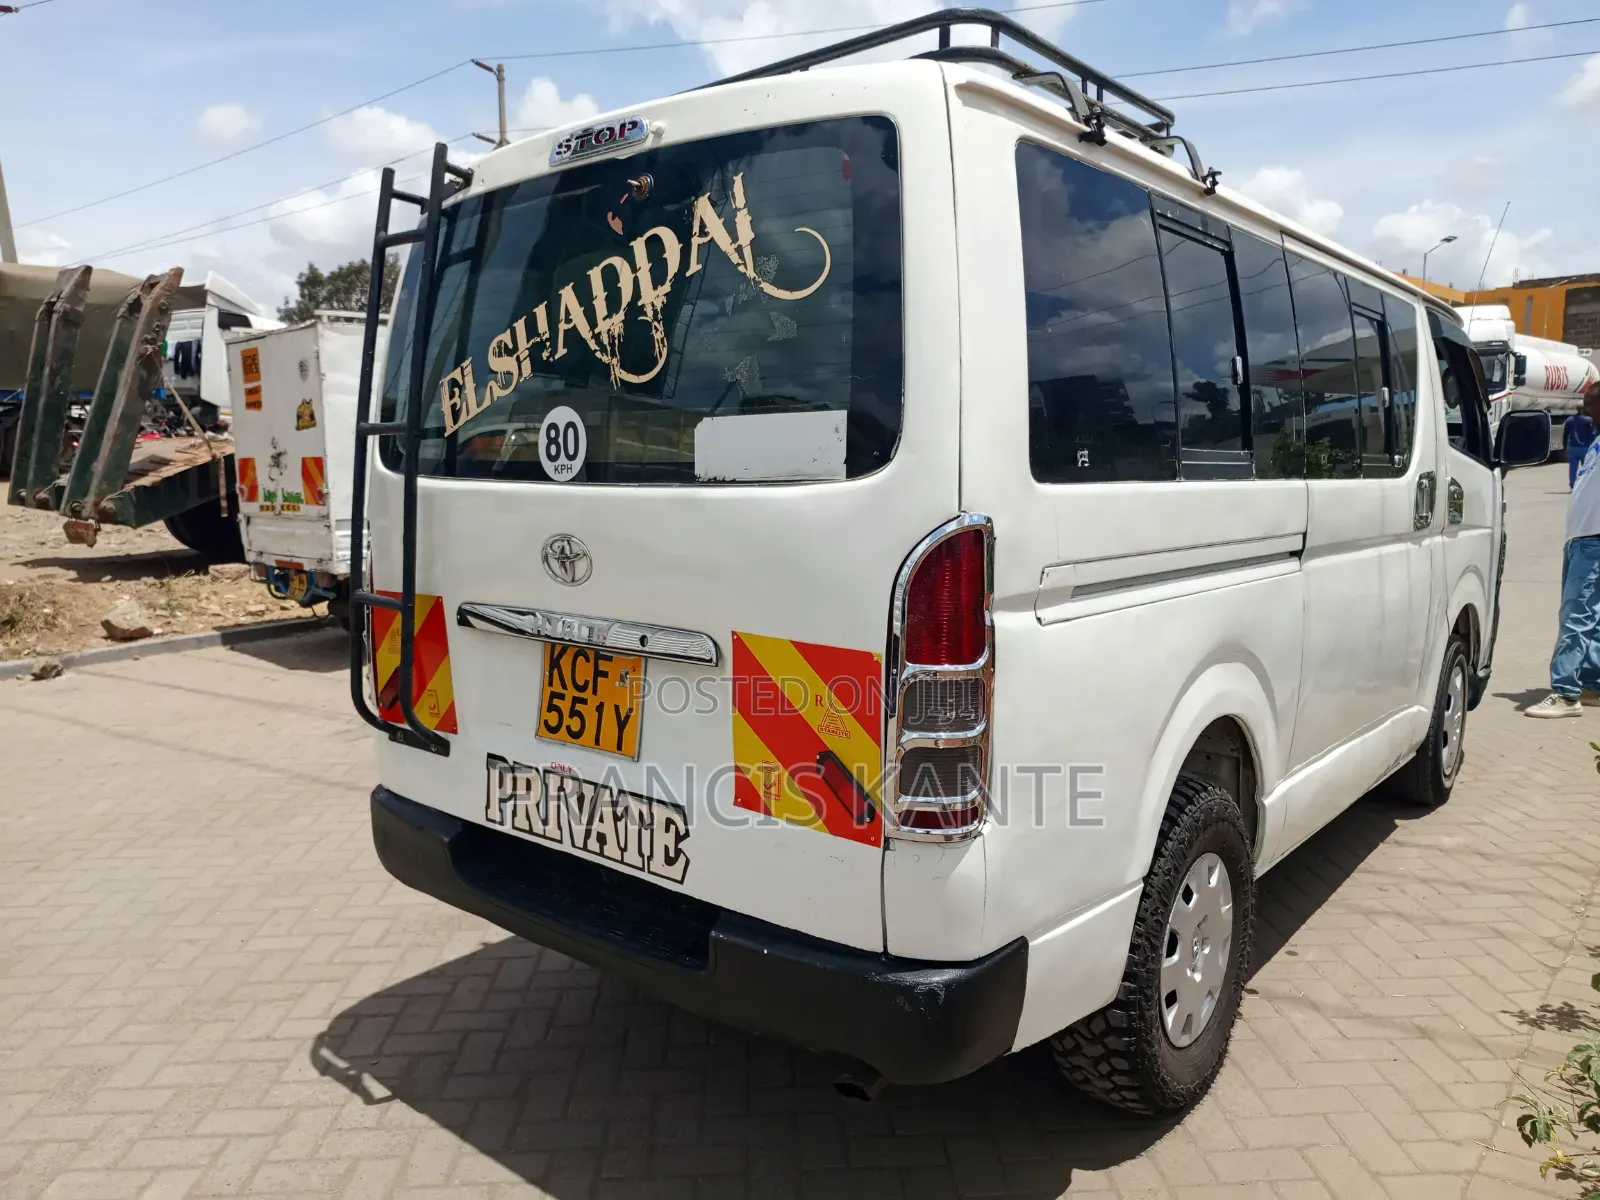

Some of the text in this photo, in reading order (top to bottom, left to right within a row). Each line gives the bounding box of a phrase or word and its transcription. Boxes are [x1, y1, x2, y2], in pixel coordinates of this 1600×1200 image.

[556, 120, 639, 156] STOP
[1544, 365, 1568, 391] RUBIS
[545, 420, 579, 463] 80
[554, 464, 573, 475] KPH
[547, 643, 613, 696] KCF
[543, 690, 634, 752] 551Y
[485, 752, 691, 886] PRIVATE
